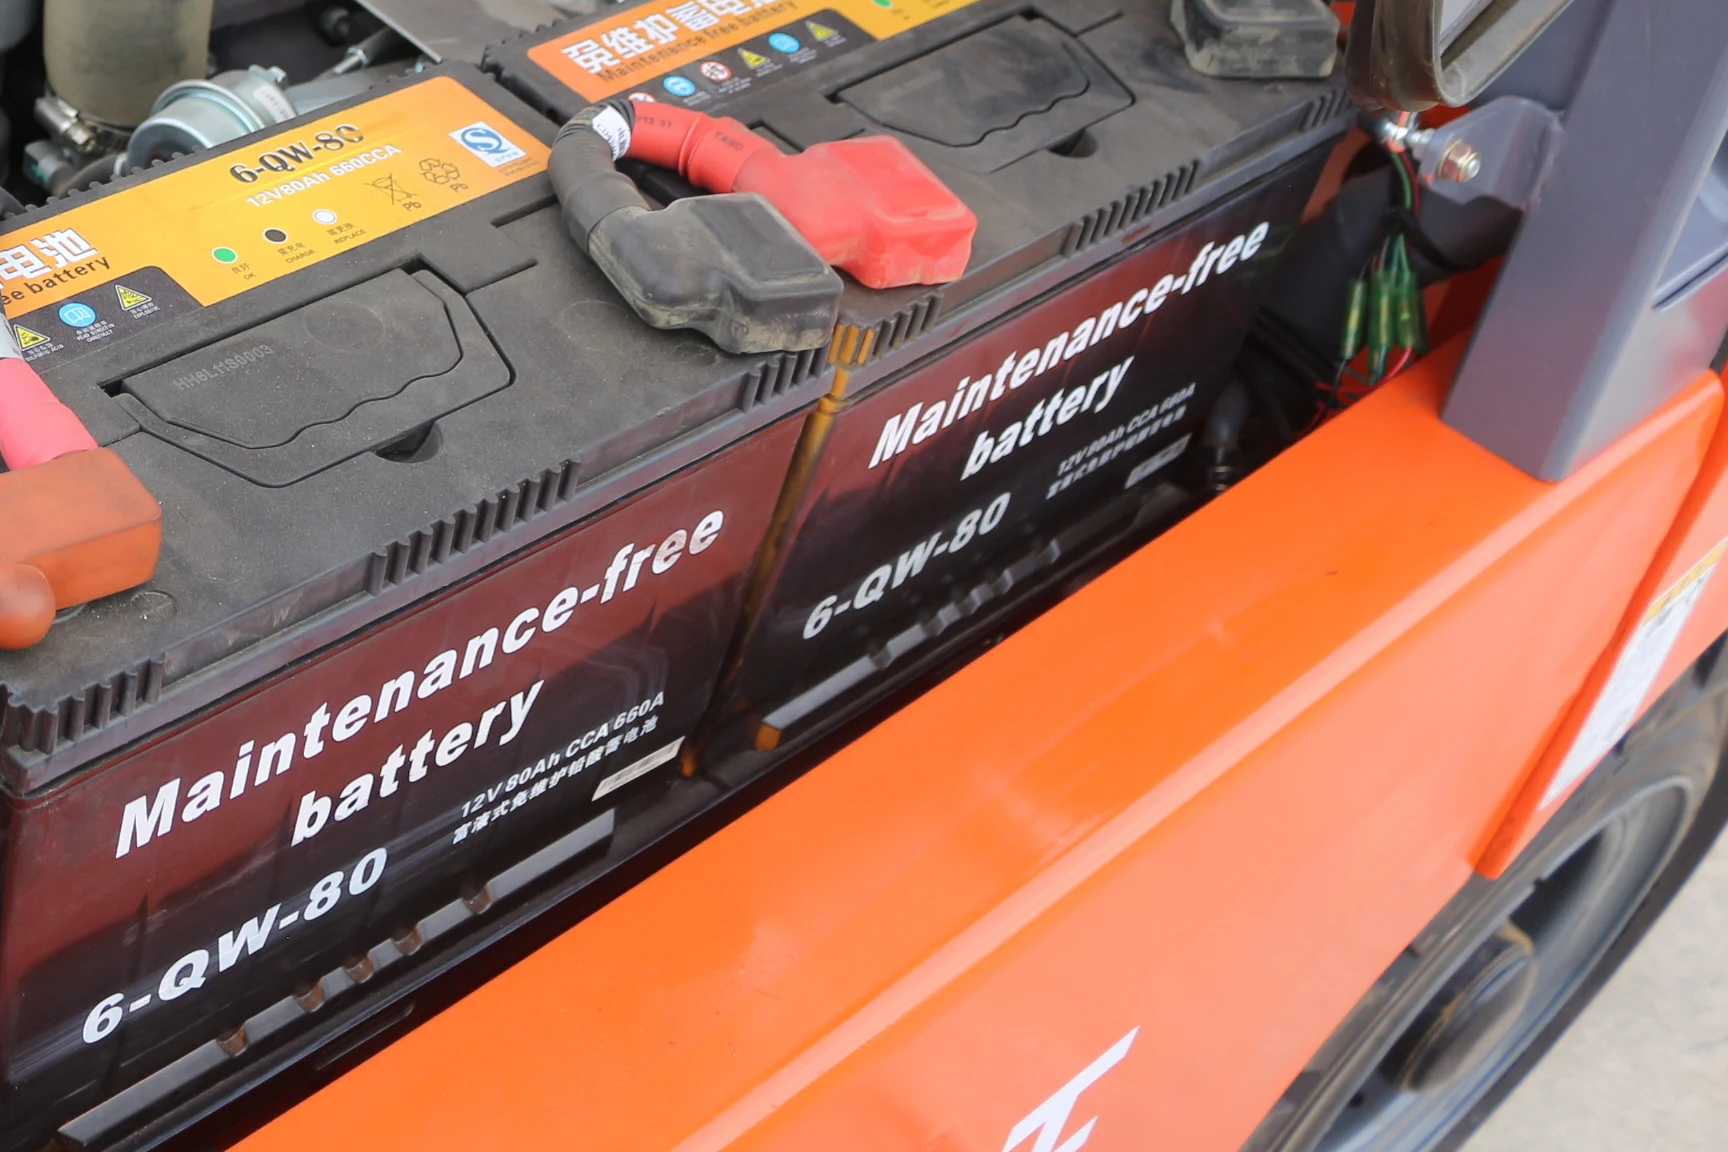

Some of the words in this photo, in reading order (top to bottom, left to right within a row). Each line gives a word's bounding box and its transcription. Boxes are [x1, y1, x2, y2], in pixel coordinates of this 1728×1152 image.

[596, 36, 707, 84] Maintenance
[246, 171, 331, 208] 12V80Ah
[331, 144, 403, 176] 660CCA
[29, 257, 112, 294] battery
[868, 221, 1270, 470] Maintenance-free
[960, 355, 1133, 481] battery
[1126, 404, 1159, 433] CCA
[802, 492, 1011, 640] 6-QW-80
[115, 508, 725, 858] Maintenance-free
[290, 680, 545, 847] battery
[453, 715, 658, 844] 富液式免维护铅酸蓄电池
[461, 783, 503, 817] 12V
[505, 753, 560, 793] 80Ah
[565, 722, 609, 759] CCA
[613, 691, 665, 731] 660A
[82, 847, 388, 1044] 6-QW-80
